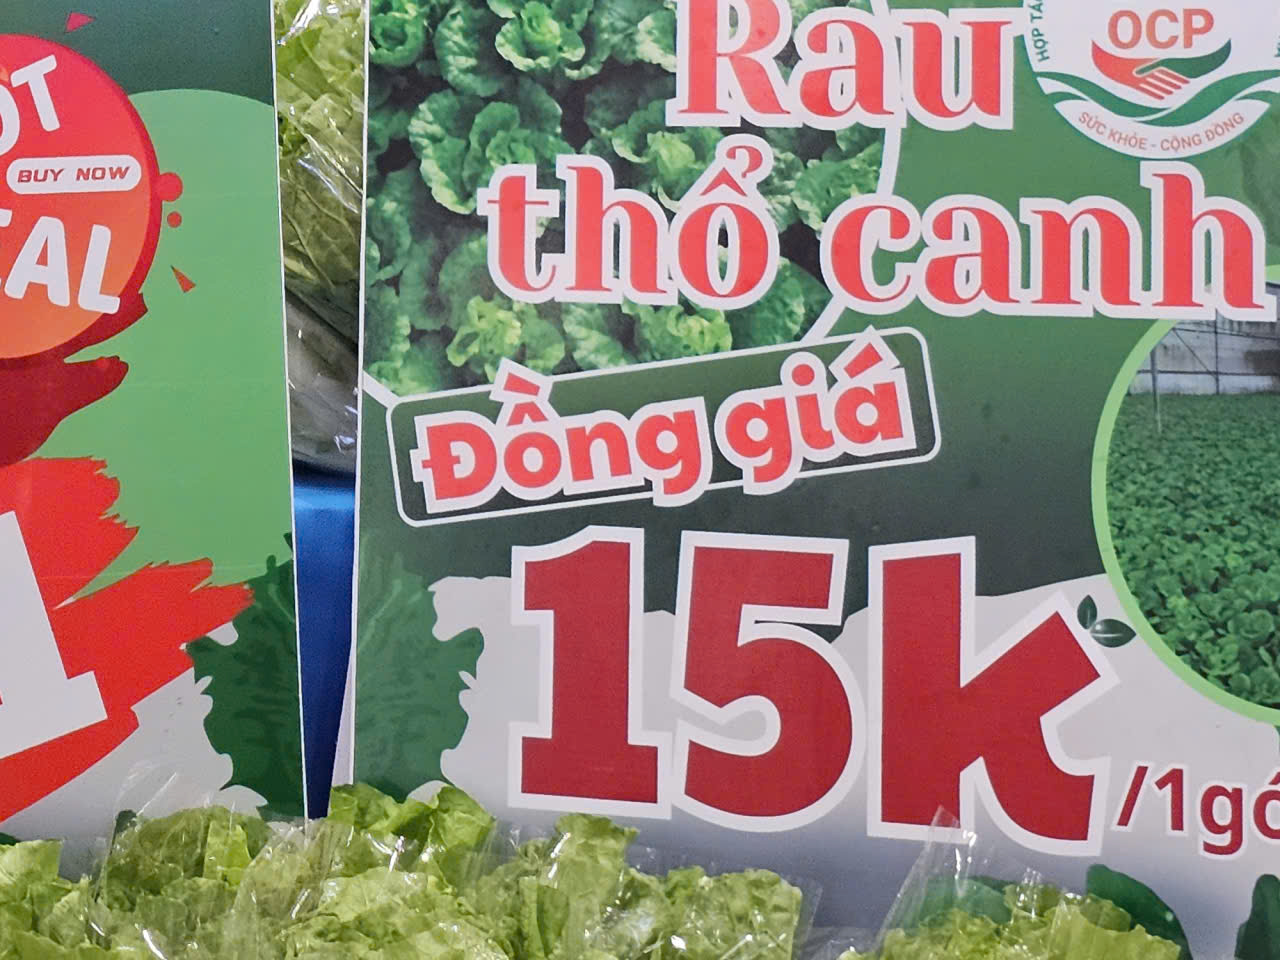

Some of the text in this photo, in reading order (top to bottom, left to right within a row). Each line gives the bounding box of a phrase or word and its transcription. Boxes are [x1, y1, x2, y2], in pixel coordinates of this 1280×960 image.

[1031, 27, 1050, 62] HỢP
[1107, 7, 1216, 51] OCP
[1077, 111, 1107, 136] SỨC
[1107, 128, 1149, 151] KHỎE
[1160, 132, 1203, 153] CỘNG
[1205, 111, 1245, 143] ĐỒNG
[17, 166, 131, 183] BUY NOW
[482, 138, 1272, 316] thổ canh
[416, 328, 912, 510] Đồng giá
[516, 532, 1112, 850] 15k
